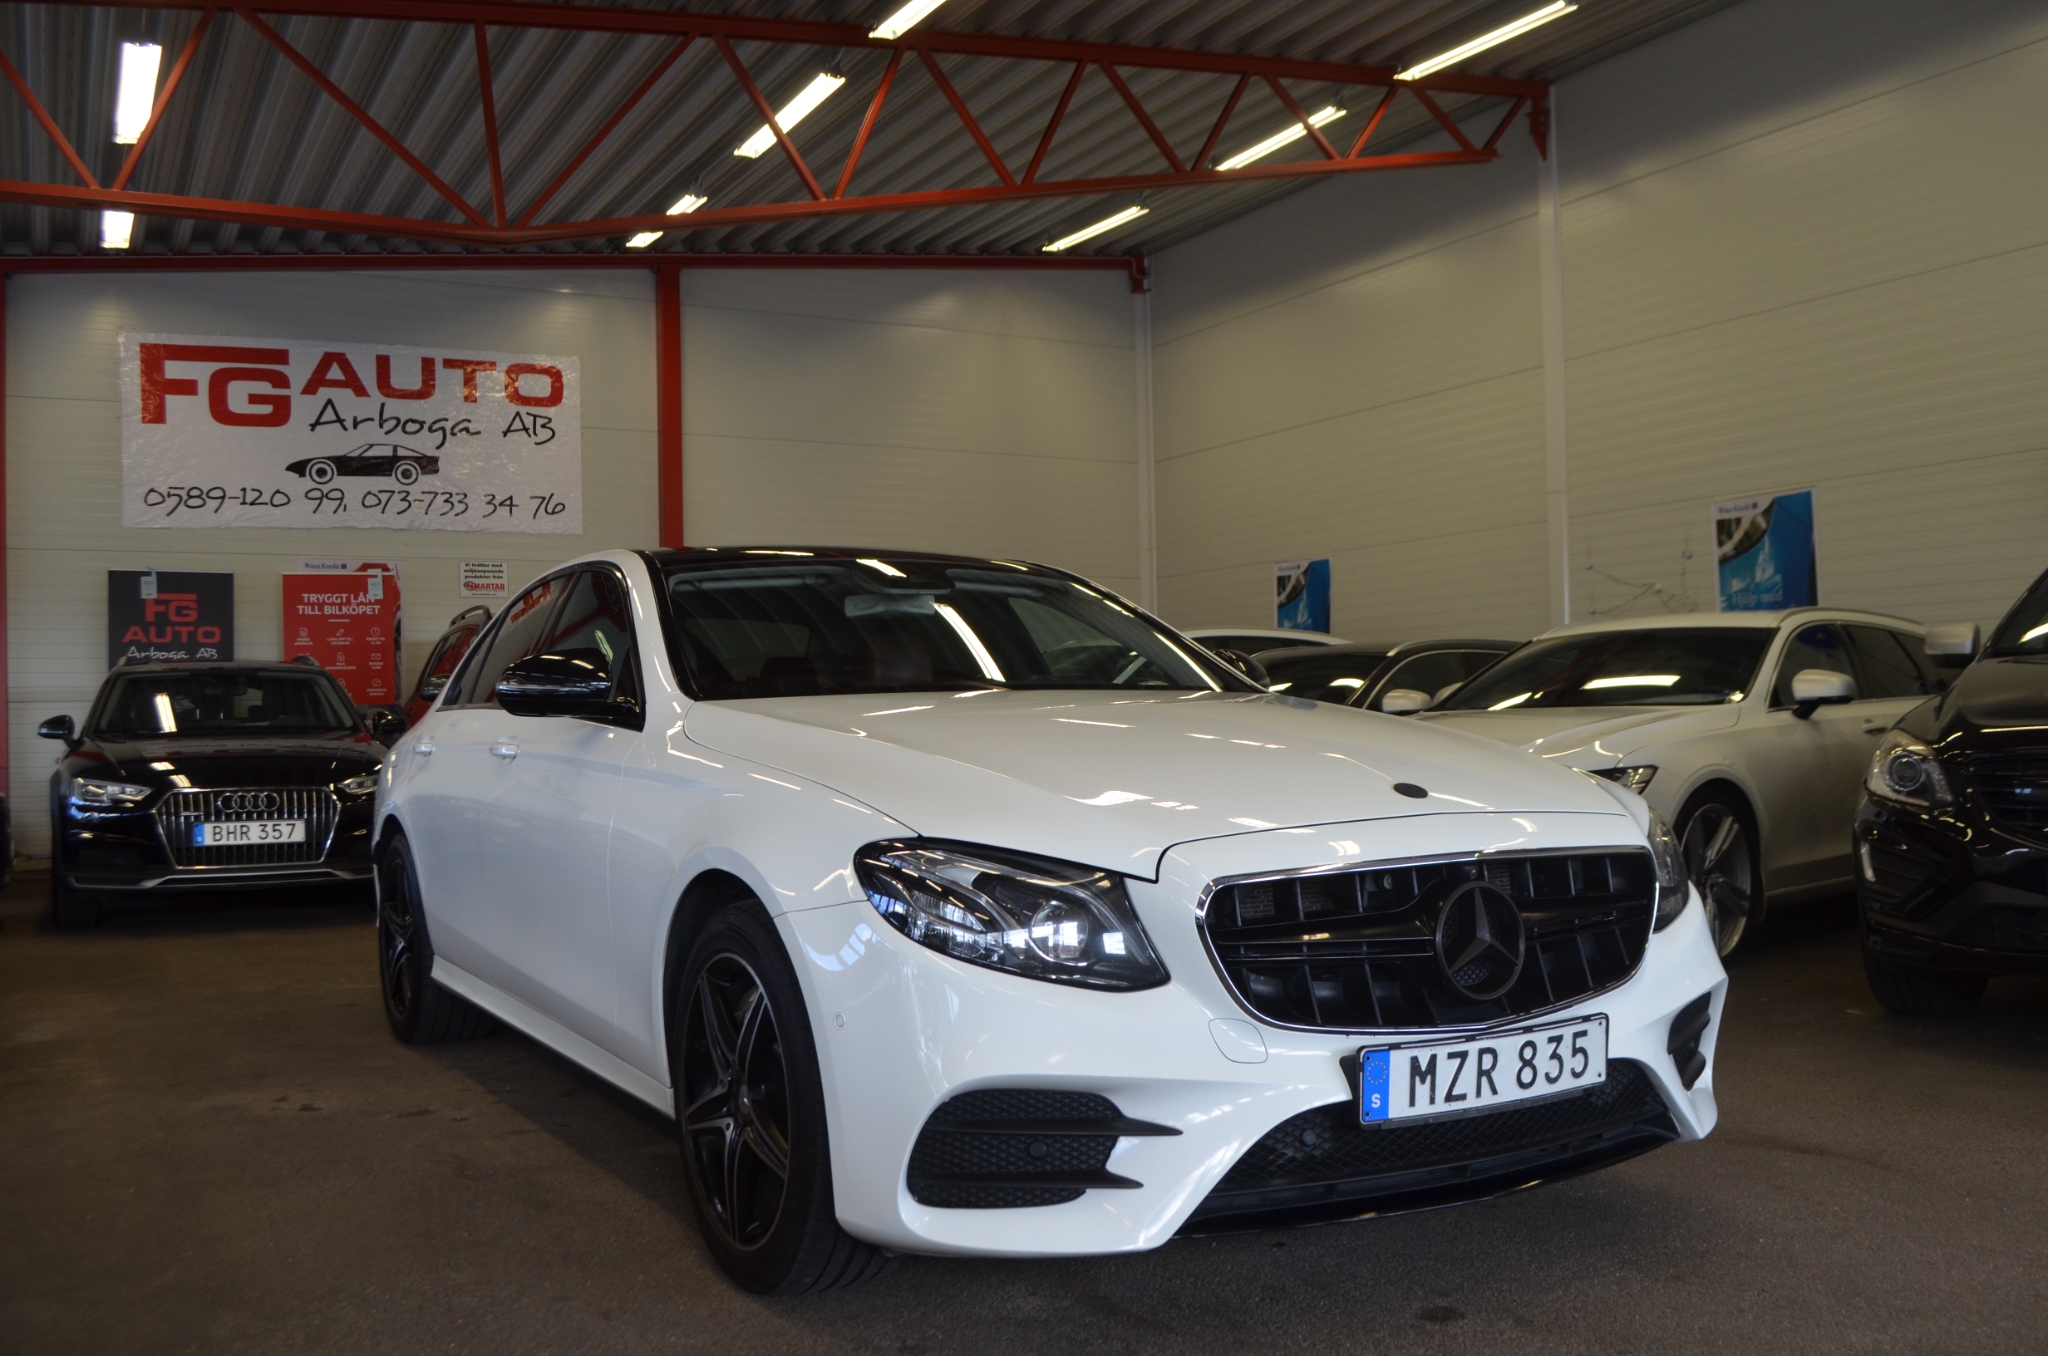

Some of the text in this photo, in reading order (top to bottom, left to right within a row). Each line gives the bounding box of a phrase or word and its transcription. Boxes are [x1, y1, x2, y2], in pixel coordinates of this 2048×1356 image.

[139, 343, 564, 427] FG AUTO
[309, 398, 555, 449] Arboga AB
[144, 487, 291, 517] 0589-120
[361, 488, 468, 516] 073-733
[482, 493, 519, 518] 34
[531, 495, 565, 520] 76
[145, 593, 198, 622] FG
[302, 594, 348, 603] TRYGGT
[297, 603, 381, 615] TILL BILKÖPET
[122, 625, 221, 643] AUTO
[127, 646, 218, 660] Arboga AB
[213, 823, 296, 842] BHR 357
[1409, 1029, 1589, 1108] MZR 835
[1371, 1093, 1381, 1108] S
